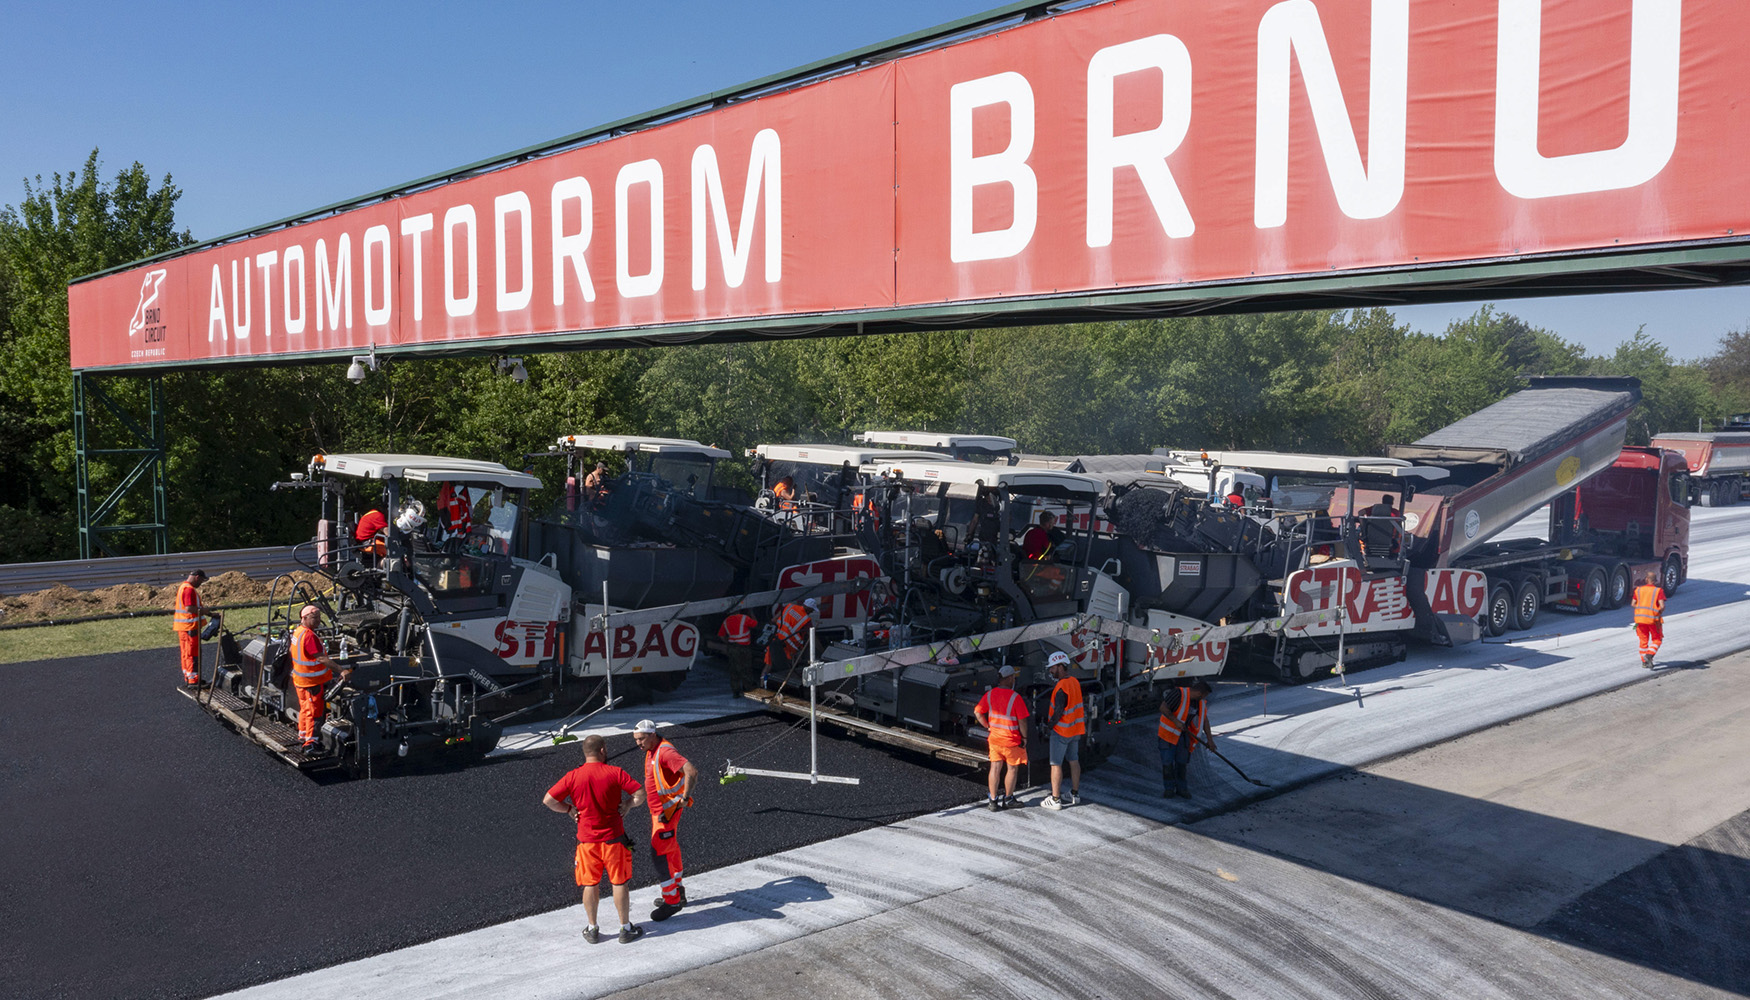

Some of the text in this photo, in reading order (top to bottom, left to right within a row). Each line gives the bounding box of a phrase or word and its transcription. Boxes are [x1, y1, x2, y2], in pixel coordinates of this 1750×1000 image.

[207, 0, 1682, 342] AUTOMOTODROM BRNO
[146, 308, 161, 324] BRNO
[145, 326, 166, 343] CIRCUIT
[131, 348, 165, 358] CZECH REPUBLIC
[468, 668, 491, 688] SUPER
